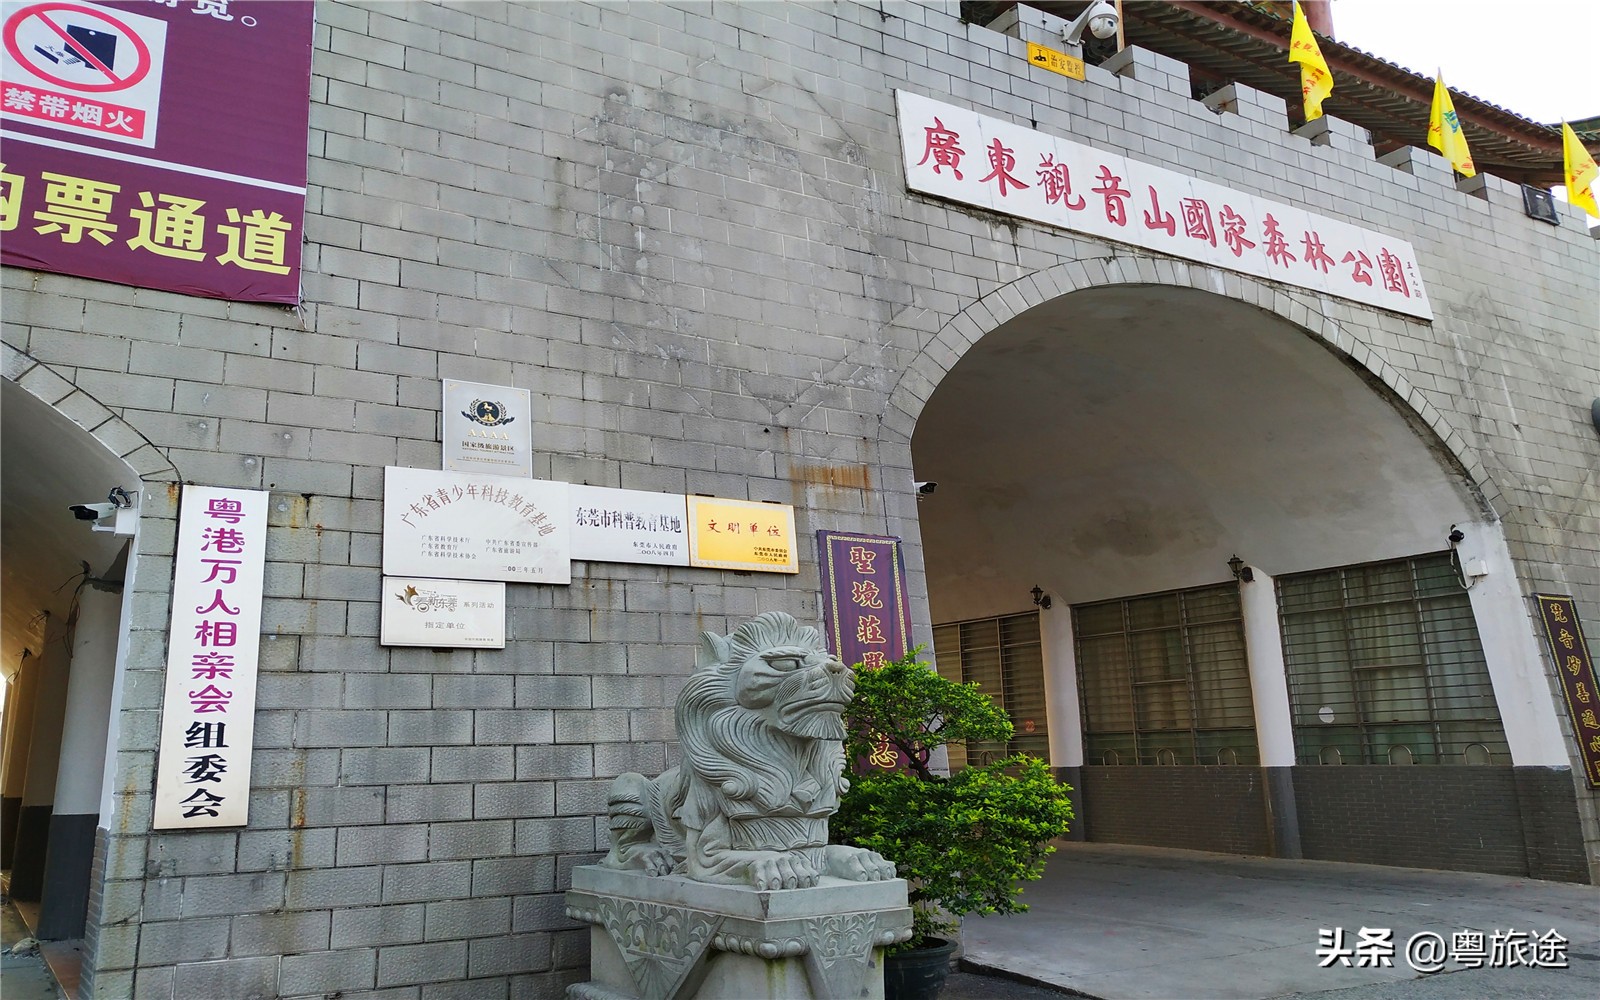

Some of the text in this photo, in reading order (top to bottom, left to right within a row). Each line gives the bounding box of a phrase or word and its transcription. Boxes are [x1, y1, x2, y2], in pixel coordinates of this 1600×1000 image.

[4, 86, 135, 133] 禁带烟火
[917, 116, 1410, 299] 廣東觀音山國家森林公園
[400, 483, 557, 537] 广东省青少年科技教育基地
[576, 507, 682, 533] 东莞市科普教育基地
[463, 601, 495, 609] 系列活动
[424, 621, 466, 630] 指定单位
